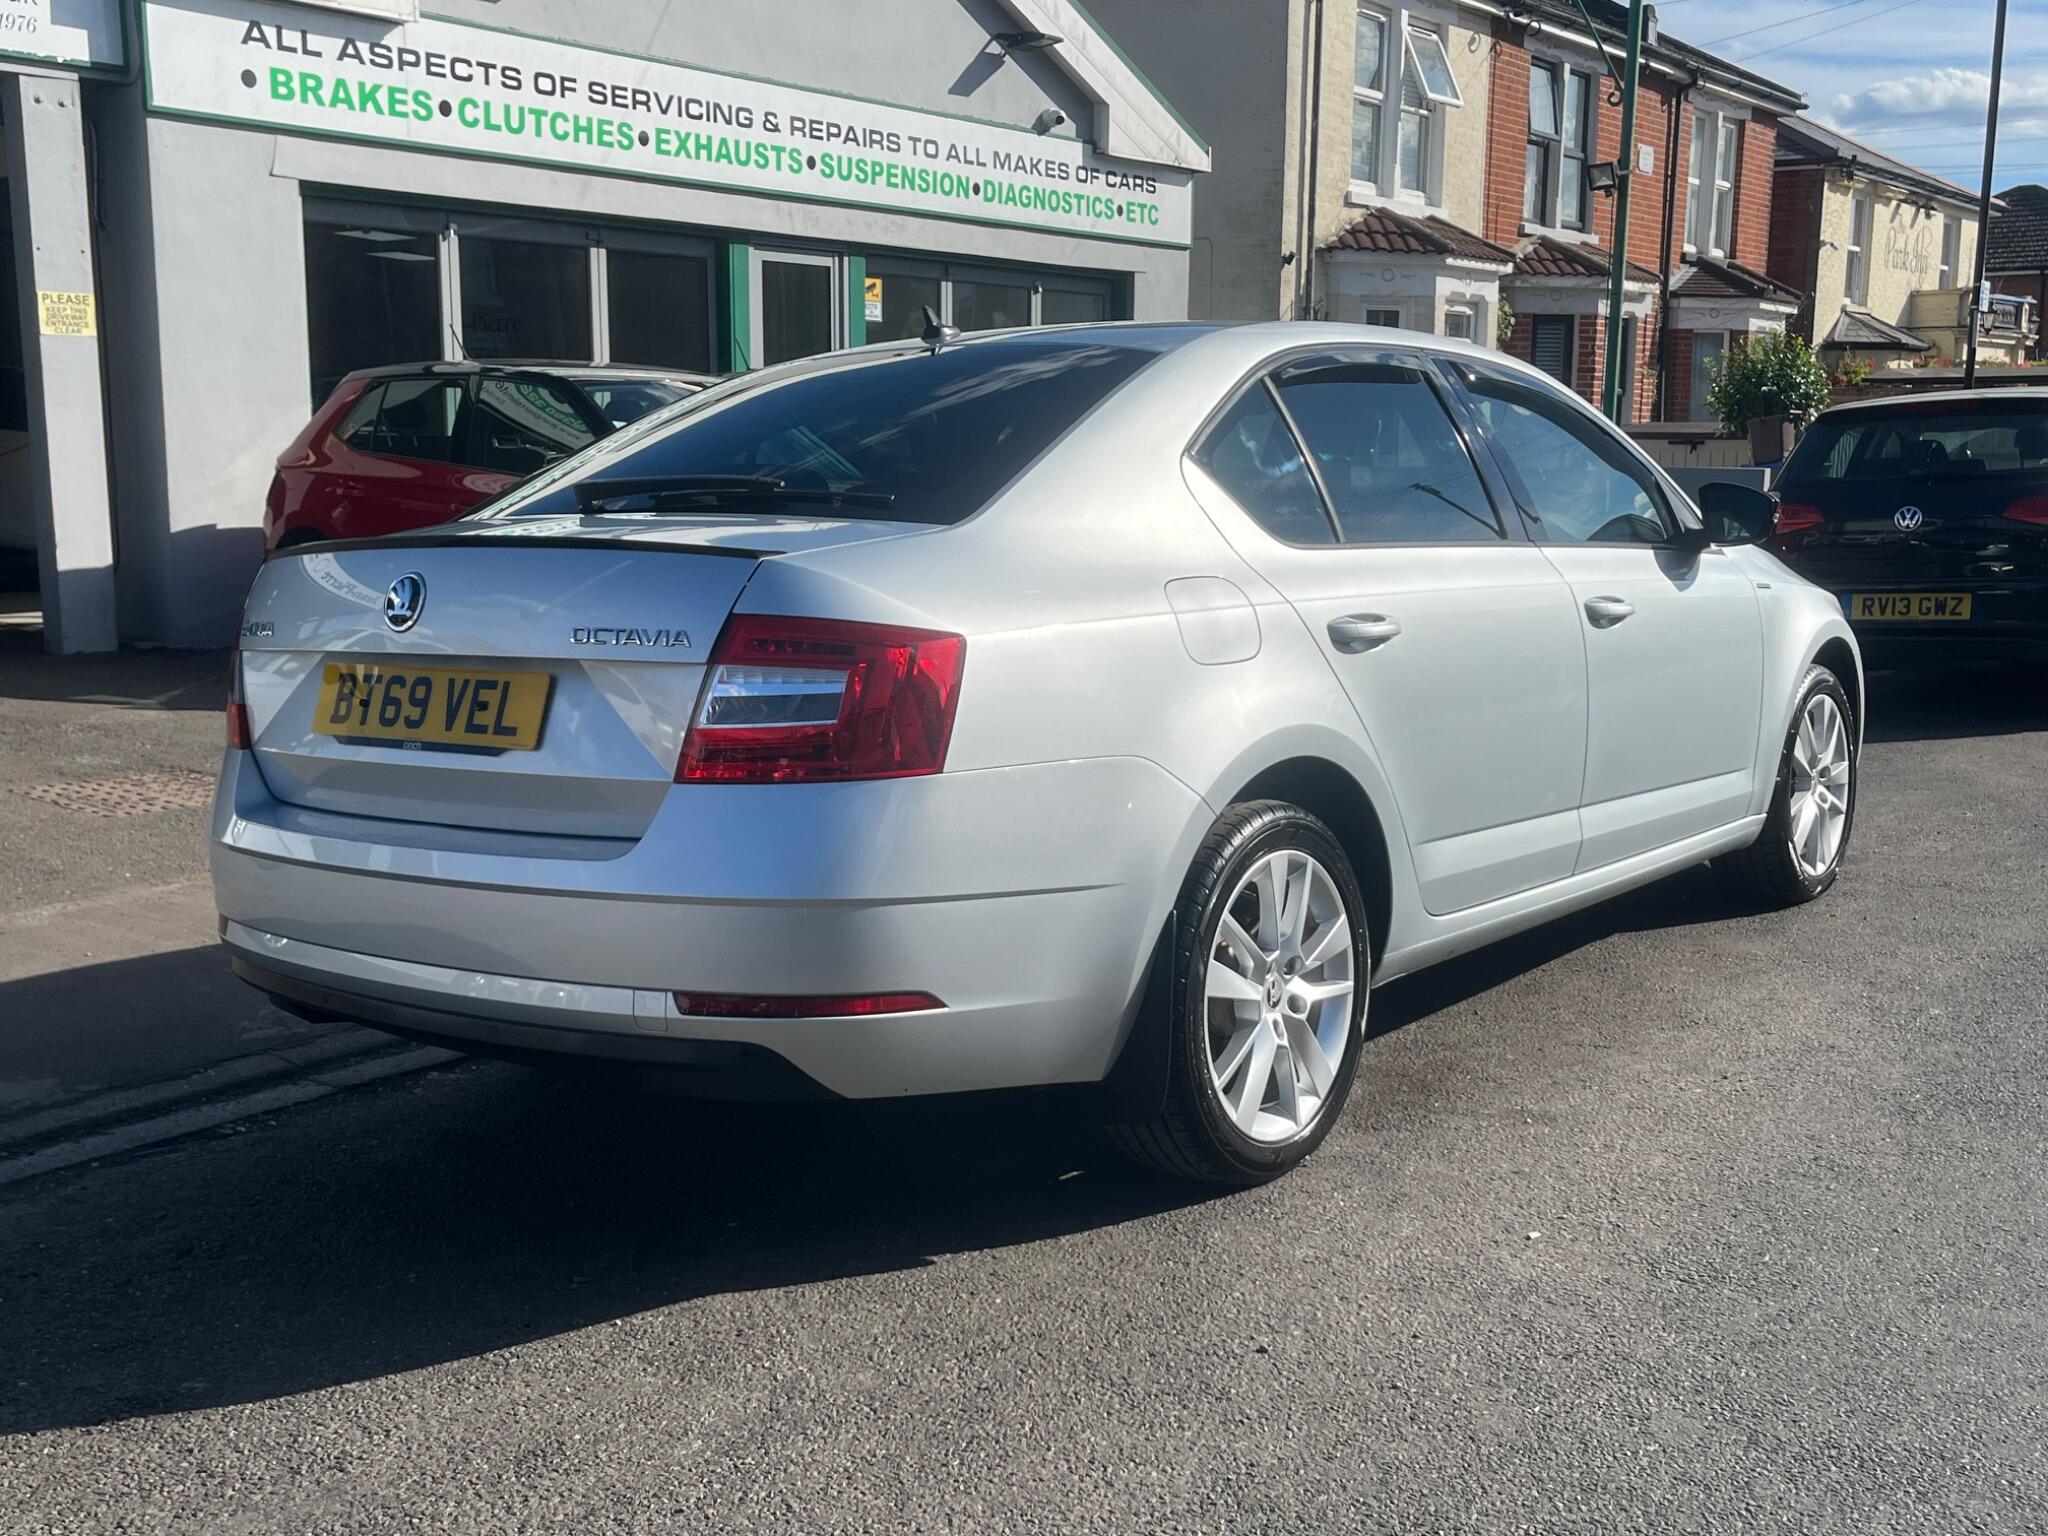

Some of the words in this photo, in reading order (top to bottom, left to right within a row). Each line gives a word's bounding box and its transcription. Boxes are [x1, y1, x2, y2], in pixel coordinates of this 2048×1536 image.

[241, 20, 322, 58] ALL
[337, 37, 522, 91] ASPECTS
[533, 71, 577, 98] OF
[588, 81, 753, 129] SERVICING
[763, 112, 781, 133] &
[789, 115, 901, 153] REPAIRS
[908, 135, 939, 159] TO
[946, 143, 987, 168] ALL
[993, 151, 1070, 181] MAKES
[1076, 166, 1099, 184] OF
[1105, 170, 1157, 194] CARS
[269, 67, 433, 122] BRAKES
[458, 97, 634, 151] CLUTCHES
[655, 127, 802, 174] EXHAUSTS
[820, 152, 971, 200] SUSPENSION
[983, 179, 1114, 221] DIAGNOSTICS
[1126, 202, 1159, 226] ETC
[1884, 226, 1909, 273] Park
[42, 293, 90, 306] PLEASE
[46, 313, 88, 321] DRIVEWAY
[70, 307, 88, 315] THIS
[46, 320, 90, 329] ENTRANCE
[1861, 596, 1911, 616] RV13
[1918, 596, 1964, 616] GWZ
[569, 626, 692, 648] OCTAVIA
[329, 672, 433, 730] BT69
[444, 677, 518, 737] VEL
